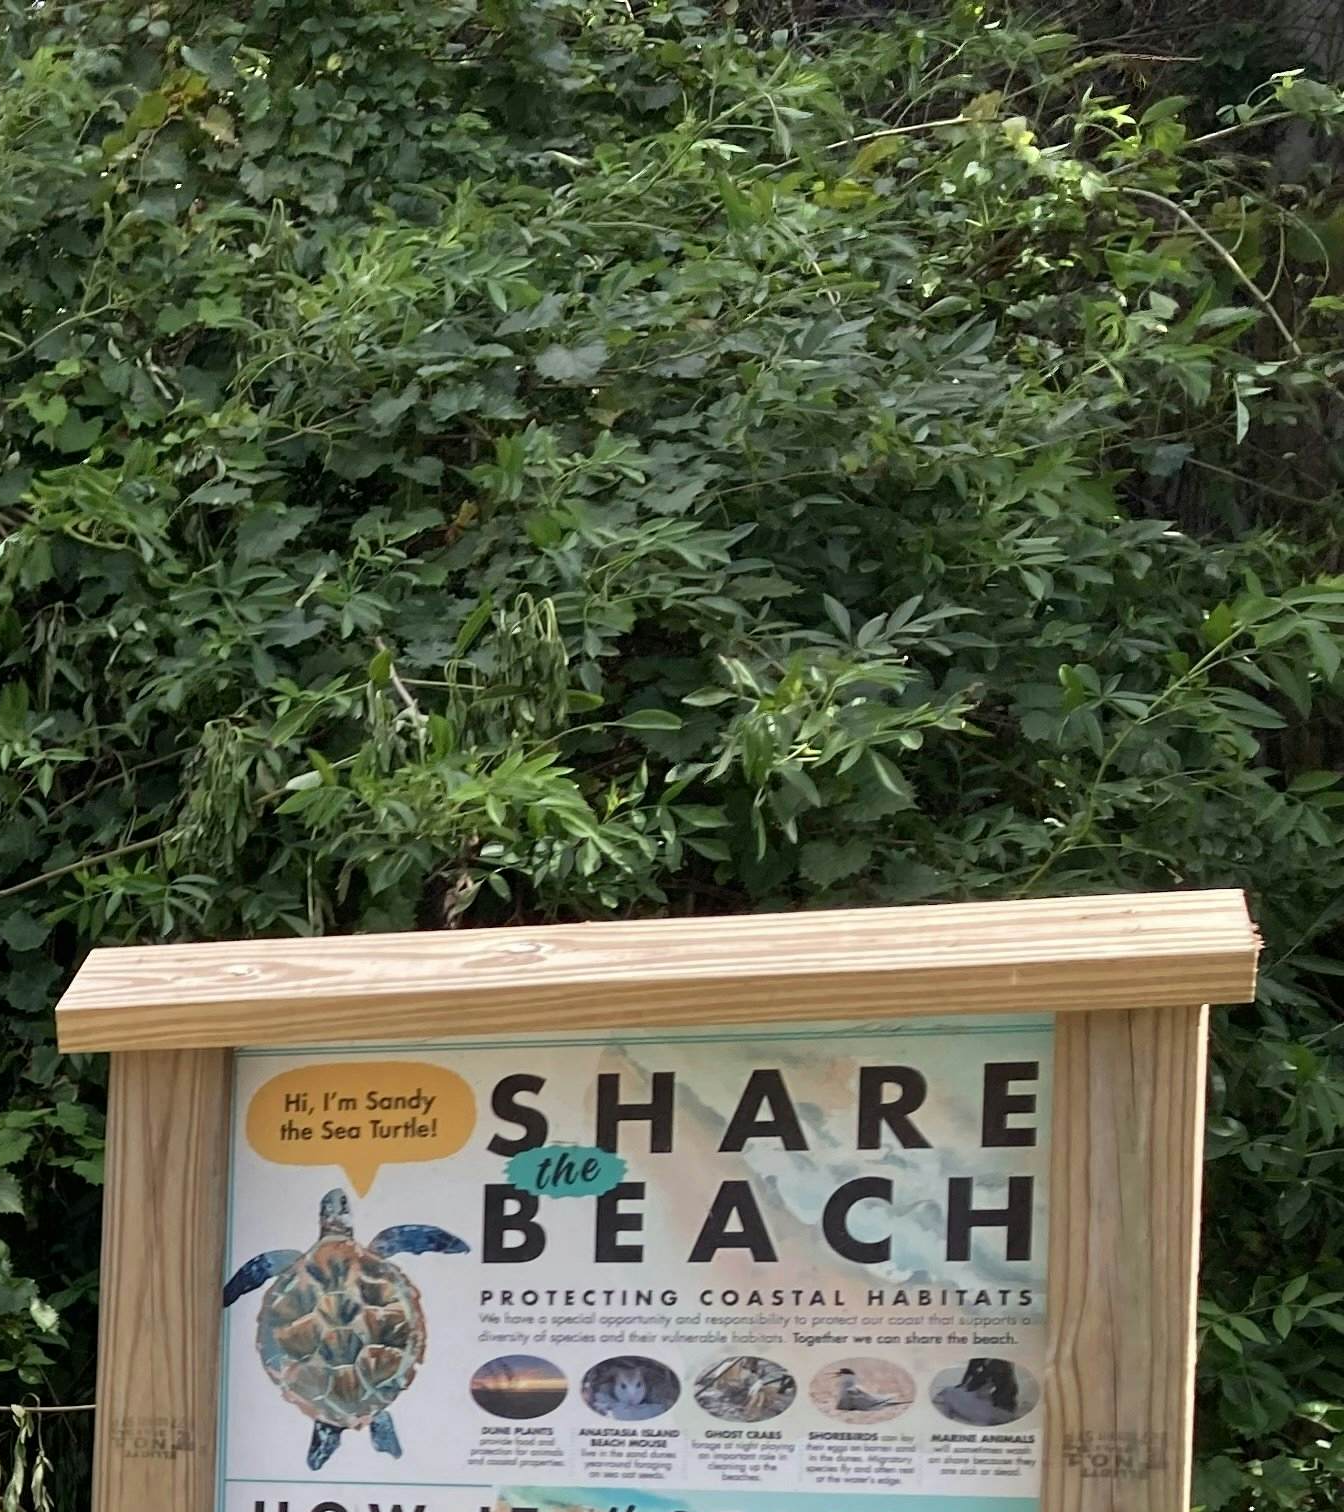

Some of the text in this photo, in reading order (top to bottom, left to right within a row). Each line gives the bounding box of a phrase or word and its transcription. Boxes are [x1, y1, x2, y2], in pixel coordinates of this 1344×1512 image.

[284, 1087, 437, 1116] Hi, I'm Sandy
[487, 1061, 1039, 1157] SHARE
[279, 1116, 437, 1141] the Sea Turtle!
[535, 1147, 606, 1189] the
[483, 1174, 1033, 1264] BEACH
[480, 1289, 1032, 1306] PROTECTING COASTAL HABITATS
[477, 1330, 530, 1345] diversity
[532, 1329, 547, 1342] of
[549, 1331, 596, 1345] species
[599, 1330, 625, 1343] and
[627, 1330, 657, 1343] their
[661, 1330, 728, 1343] vulnerable
[791, 1330, 849, 1347] Together
[852, 1335, 872, 1344] we
[875, 1335, 901, 1344] can
[904, 1330, 943, 1344] share
[946, 1331, 968, 1344] the
[971, 1331, 1019, 1345] beach.
